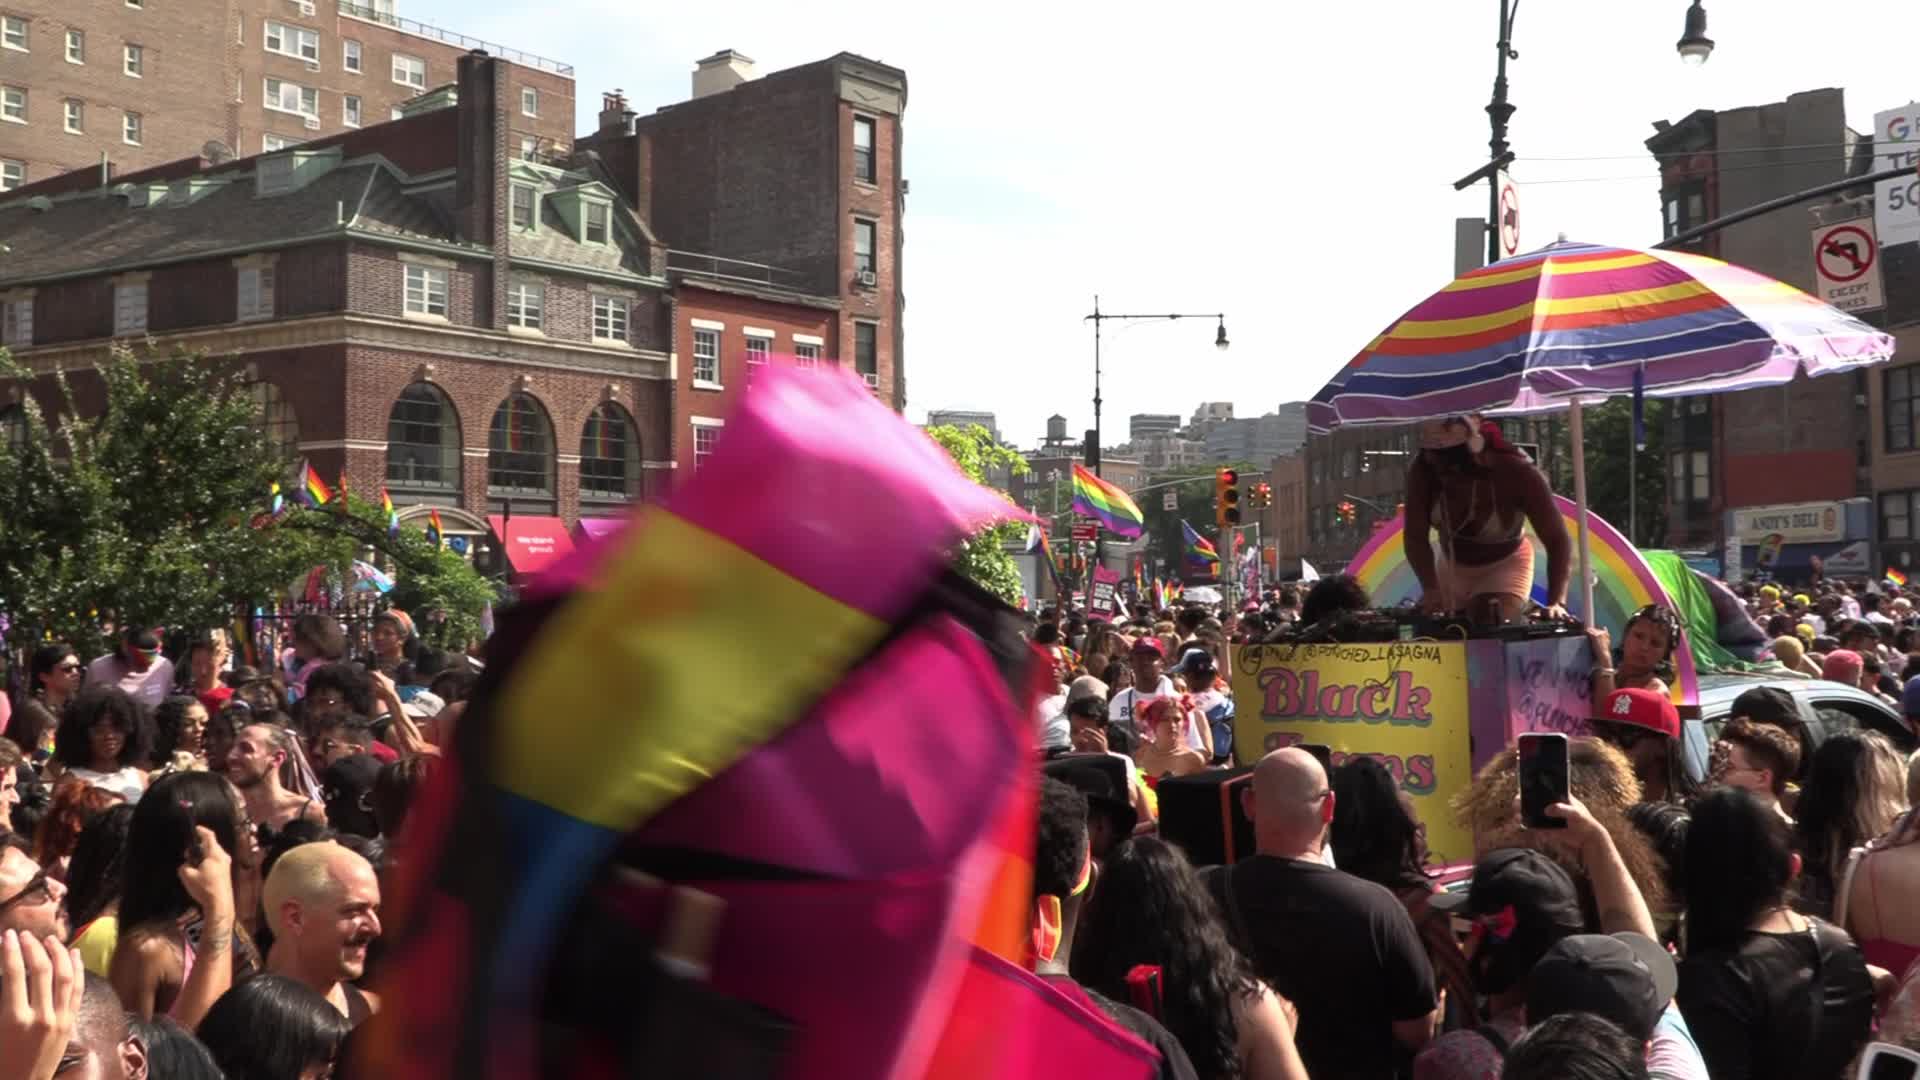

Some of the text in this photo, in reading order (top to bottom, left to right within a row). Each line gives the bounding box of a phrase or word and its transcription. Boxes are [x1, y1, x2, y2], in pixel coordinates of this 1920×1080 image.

[1829, 282, 1869, 298] EXCEPT
[1752, 512, 1819, 530] ANDY'S DELI
[1258, 667, 1434, 727] Black
